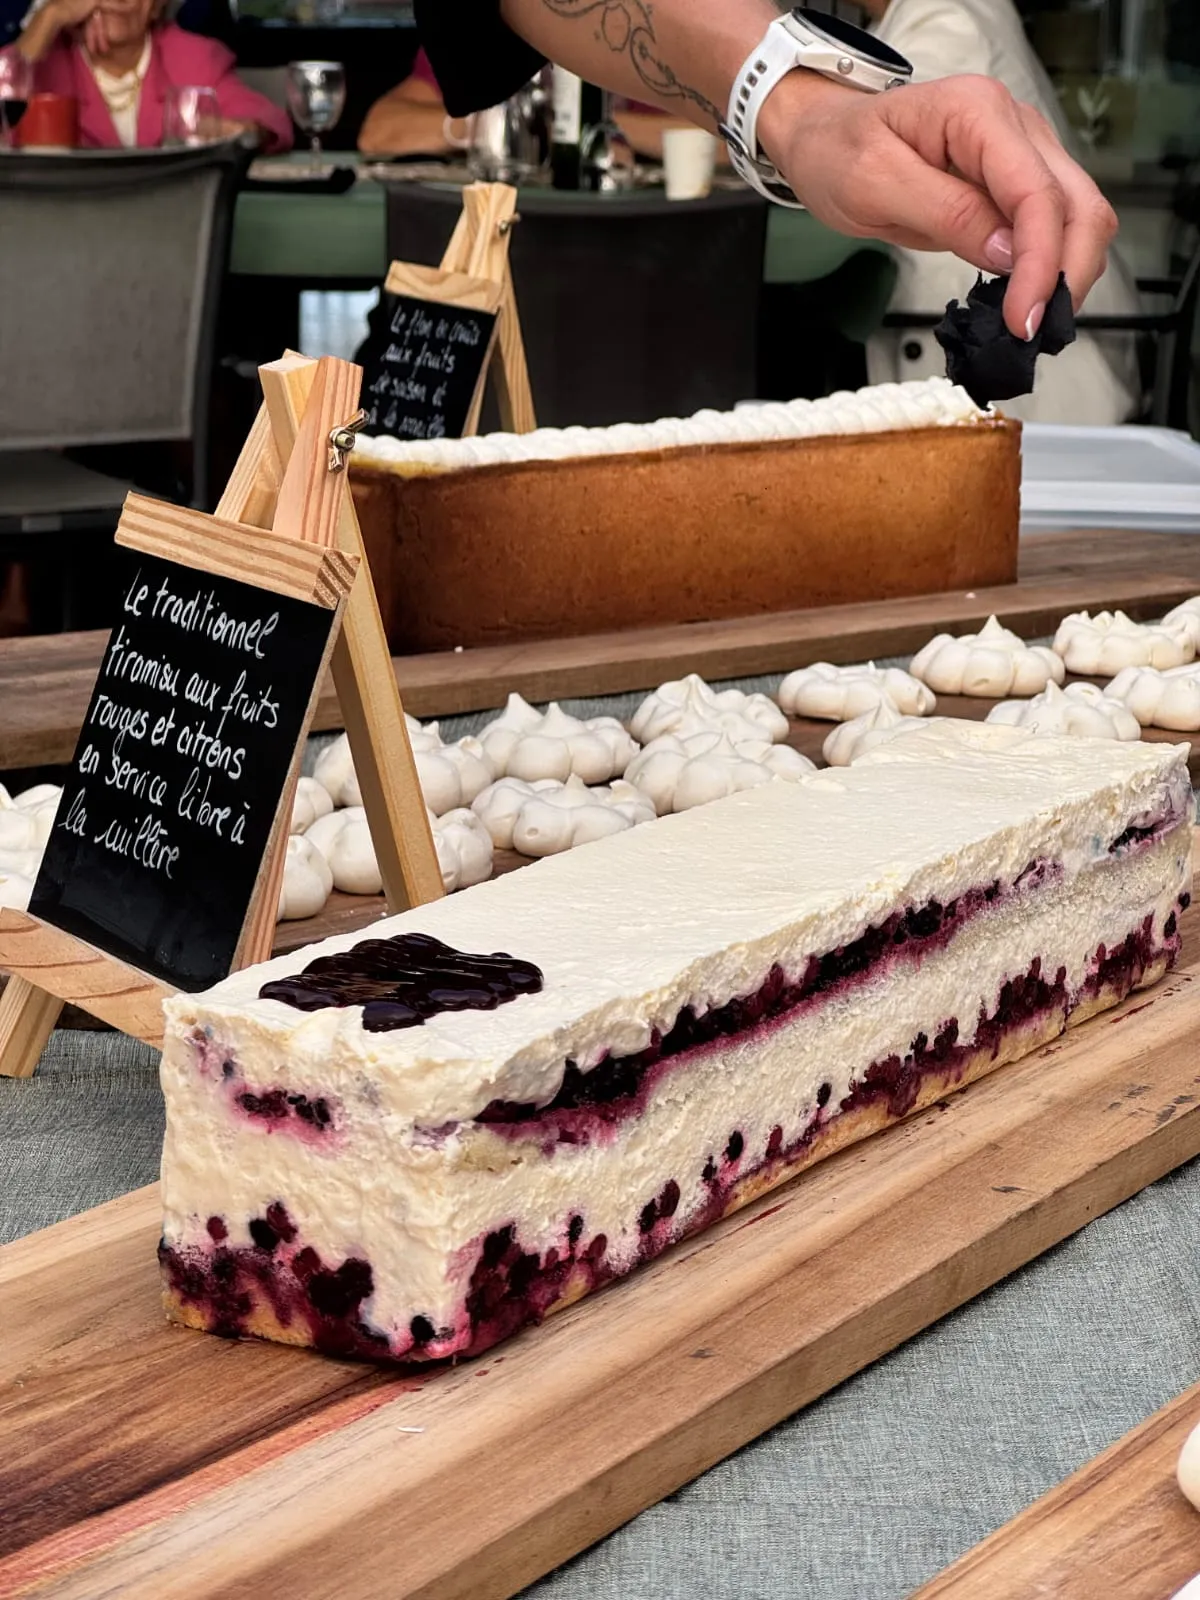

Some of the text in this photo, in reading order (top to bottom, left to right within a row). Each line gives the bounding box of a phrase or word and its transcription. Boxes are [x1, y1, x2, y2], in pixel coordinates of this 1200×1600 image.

[380, 341, 456, 378] aux fruits
[123, 567, 279, 659] Le traditionnel
[105, 625, 279, 736] tiramisu aux fruits
[89, 695, 246, 780] rouges et citrons
[57, 788, 88, 841] la
[79, 744, 251, 845] en service libre à
